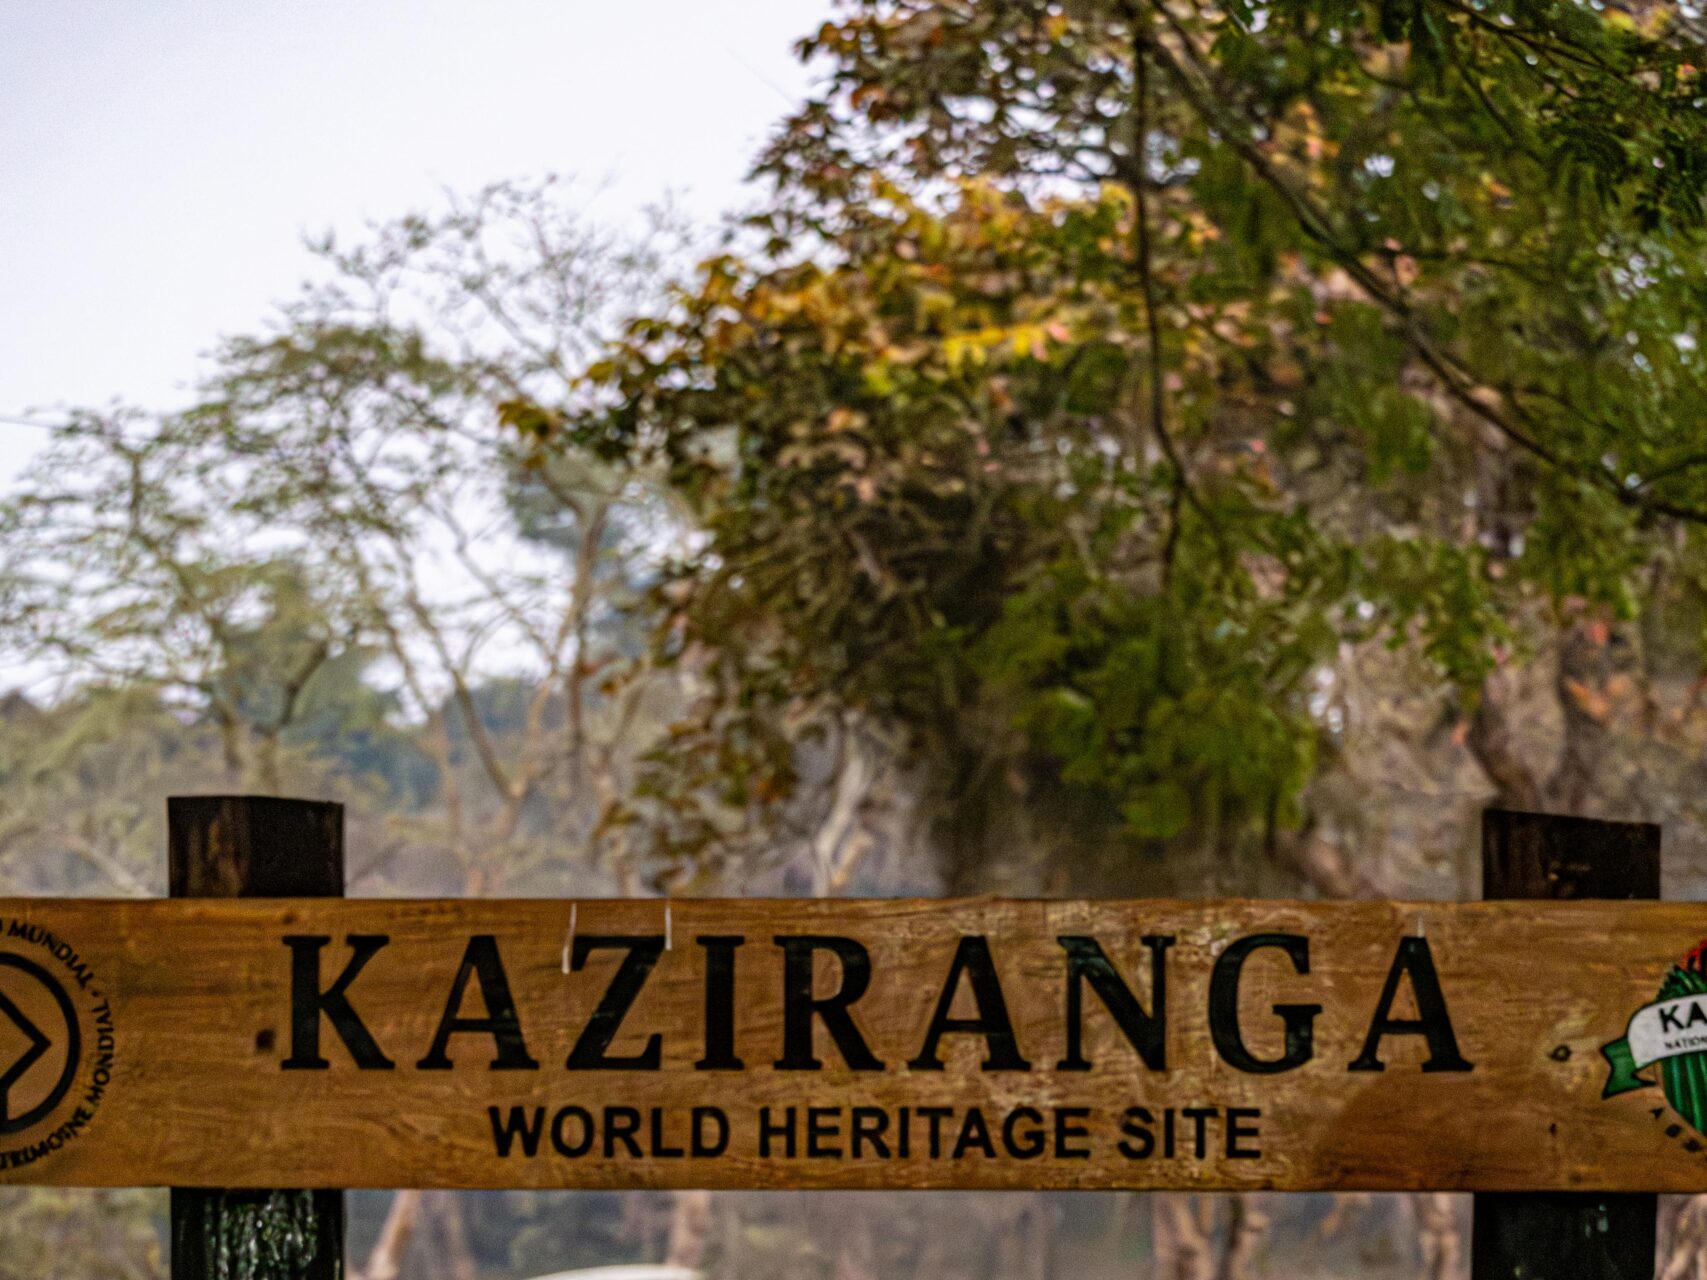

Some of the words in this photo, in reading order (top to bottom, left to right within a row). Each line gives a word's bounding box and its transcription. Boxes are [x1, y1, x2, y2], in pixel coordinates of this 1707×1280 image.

[280, 933, 1476, 1075] KAZIRANGA
[487, 1105, 731, 1160] WORLD
[757, 1105, 1093, 1161] HERITAGE
[1116, 1106, 1263, 1161] SITE
